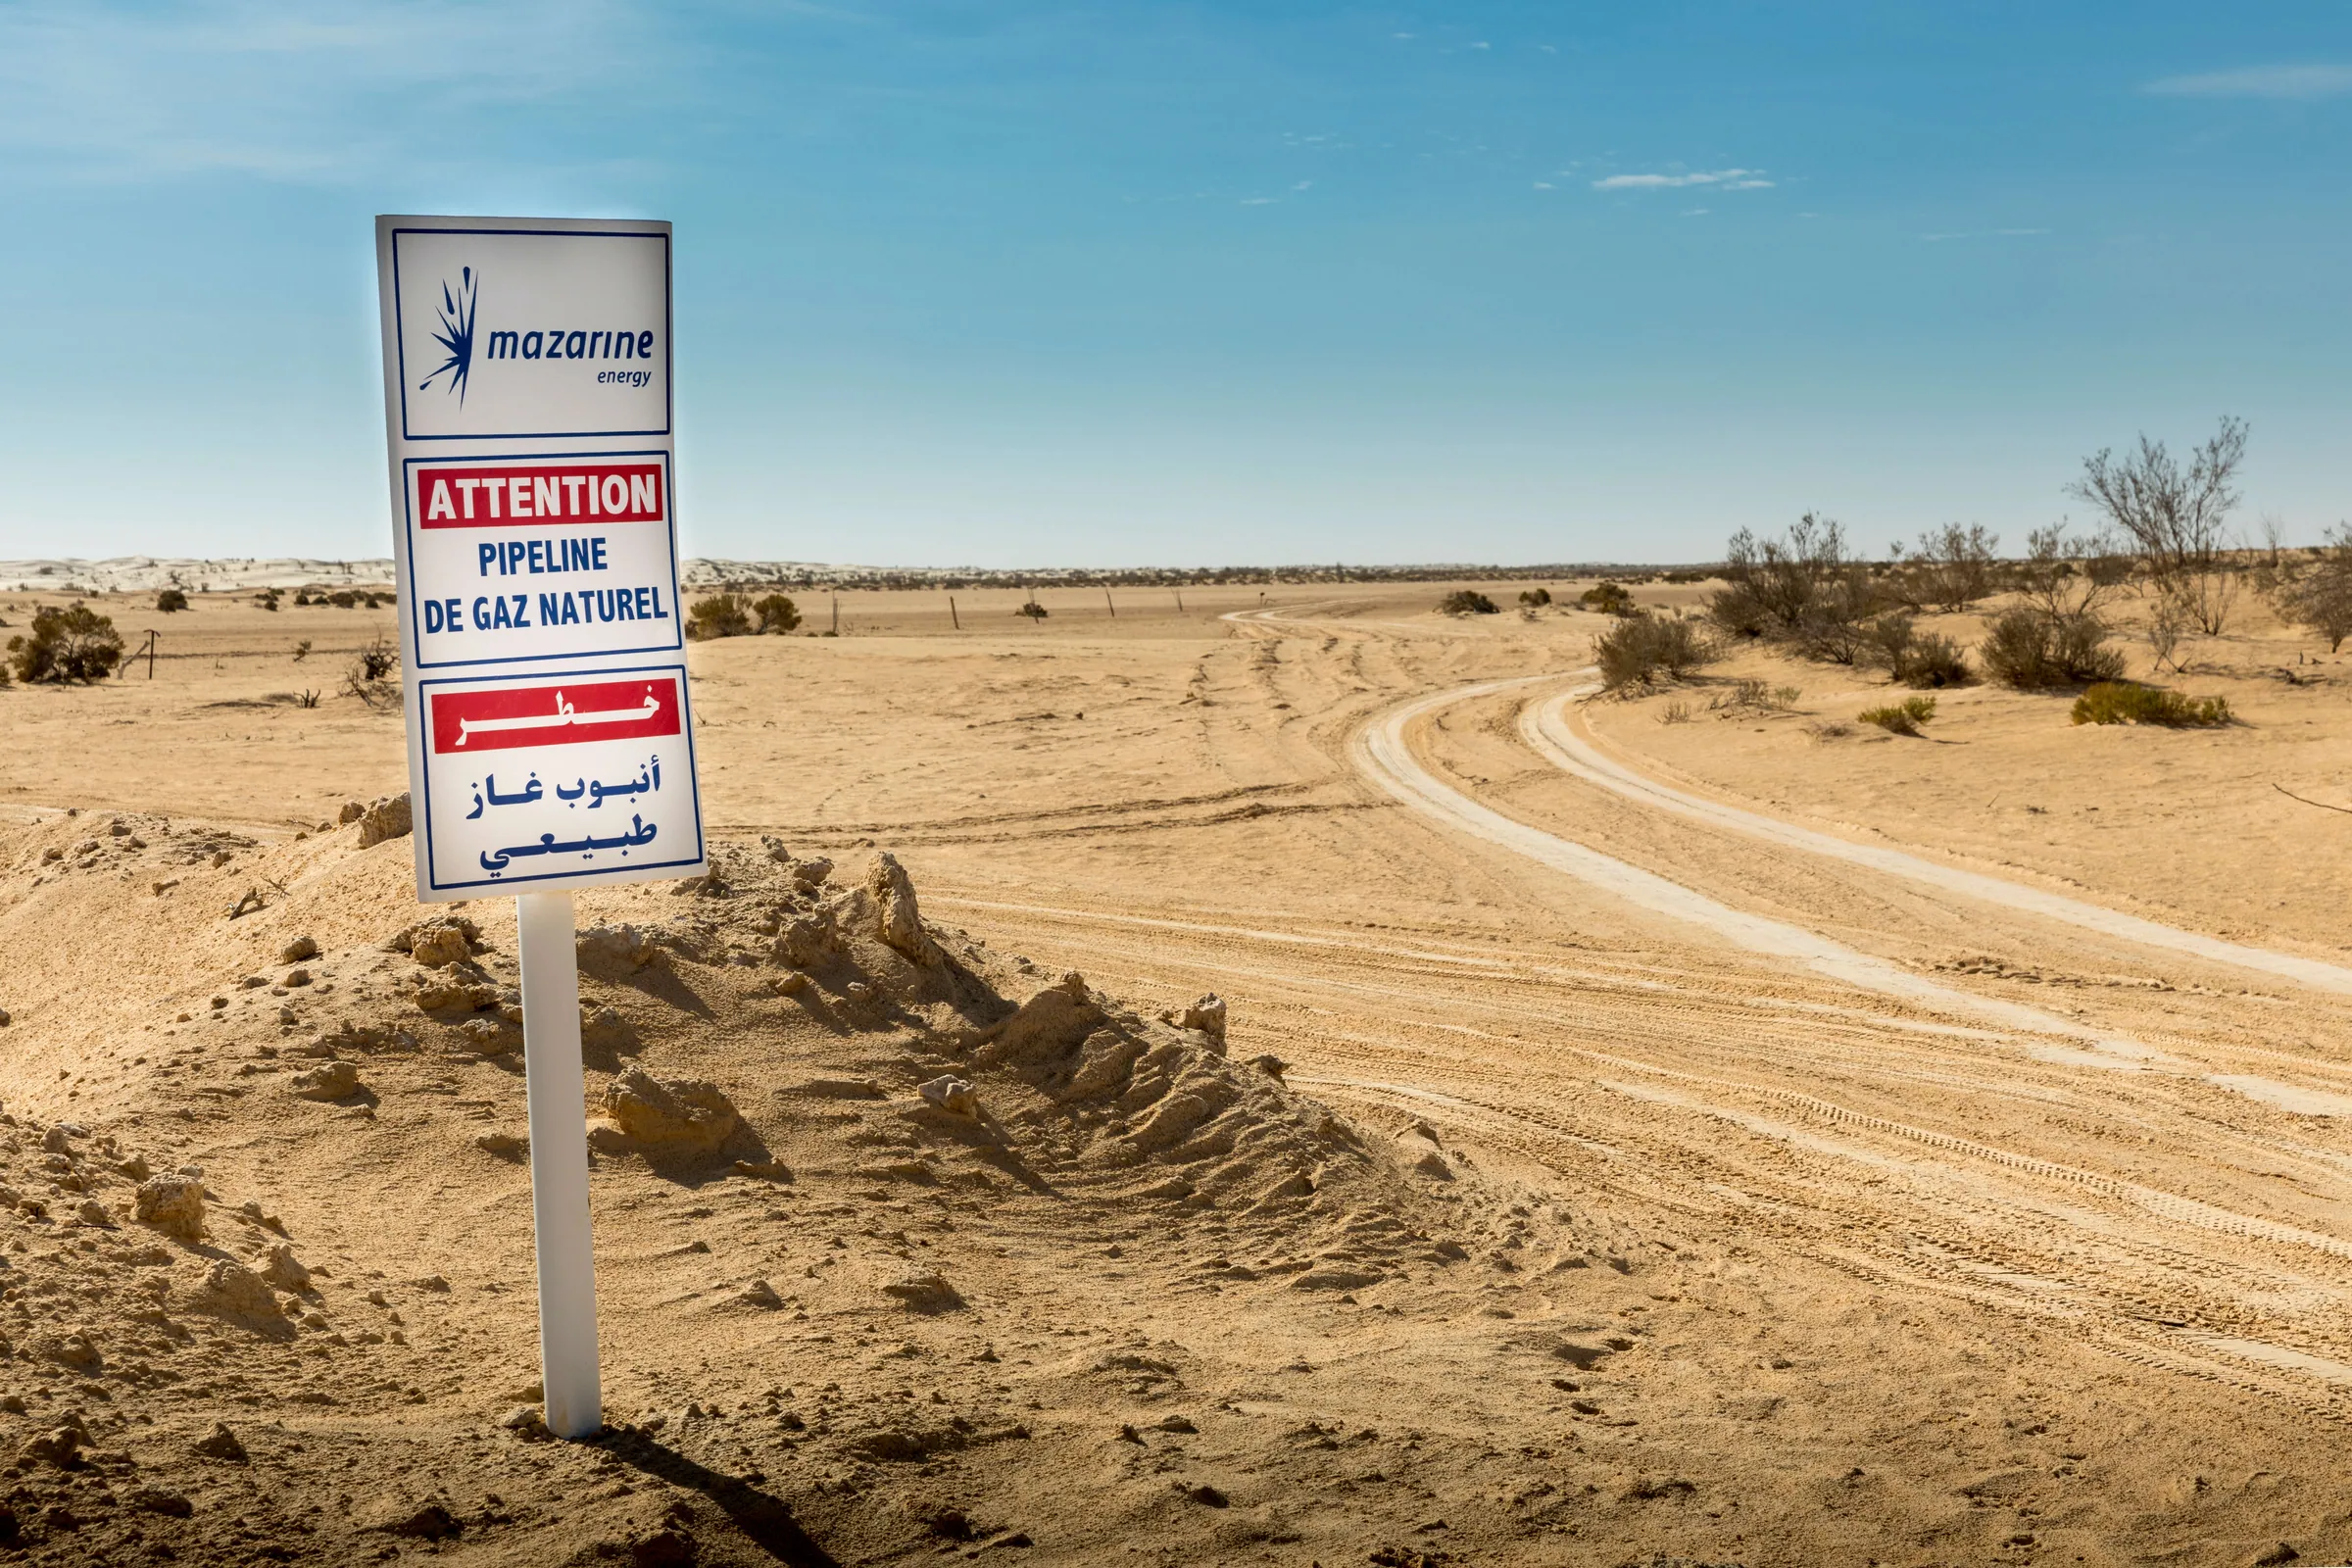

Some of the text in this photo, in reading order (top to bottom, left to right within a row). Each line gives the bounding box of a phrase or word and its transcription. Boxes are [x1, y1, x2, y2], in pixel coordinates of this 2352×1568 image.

[487, 329, 655, 360] mazarine
[597, 368, 652, 388] energy
[427, 473, 657, 520] ATTENTION
[478, 537, 608, 577] PIPELINE
[423, 586, 668, 634] DE GAZ NATUREL
[455, 684, 661, 746] خطر
[466, 754, 661, 820] أنبوب غاز
[479, 812, 658, 878] طبيعي
